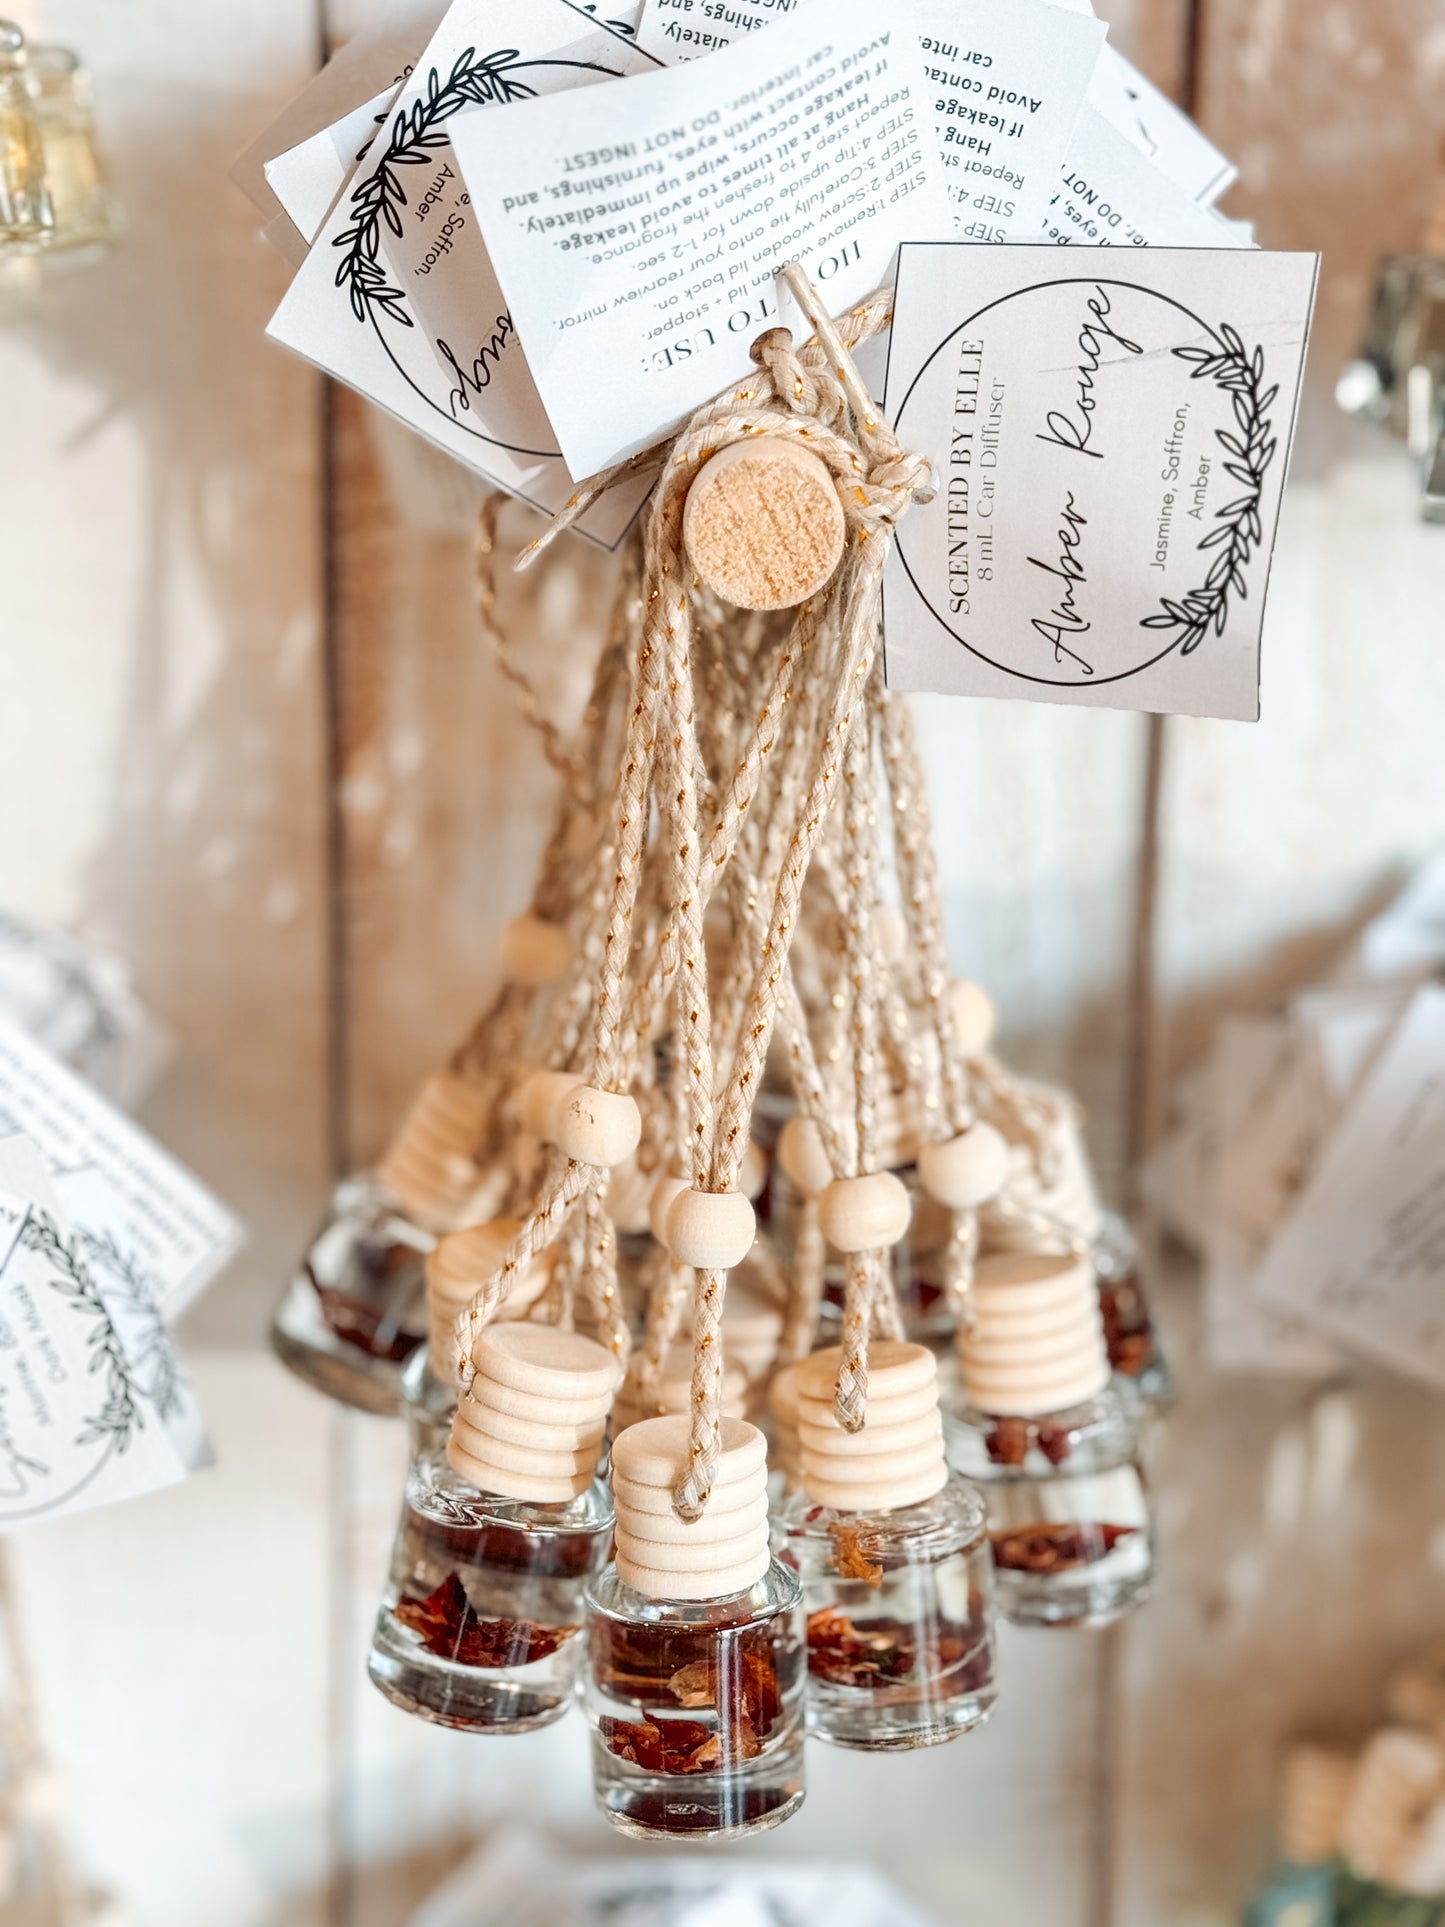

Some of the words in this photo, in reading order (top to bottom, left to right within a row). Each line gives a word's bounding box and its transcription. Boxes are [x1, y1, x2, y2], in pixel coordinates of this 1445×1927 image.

[806, 45, 834, 69] car
[840, 34, 890, 73] Avoid
[918, 35, 959, 62] inte
[962, 50, 993, 68] car
[874, 58, 888, 77] If
[723, 64, 803, 116] interior.
[767, 66, 837, 115] contact
[804, 69, 871, 117] leakage
[986, 85, 1043, 114] Avoid
[690, 109, 722, 133] DO
[823, 92, 870, 128] Hang
[855, 85, 911, 129] Repeat
[934, 98, 1006, 134] leakage
[644, 126, 687, 153] NOT
[722, 110, 764, 139] with
[732, 113, 800, 155] occurs,
[802, 123, 821, 141] at
[816, 124, 850, 151] step
[876, 107, 914, 141] STEP
[1007, 121, 1024, 139] If
[552, 141, 639, 174] INGEST.
[667, 134, 719, 163] eyes,
[775, 136, 799, 159] all
[800, 150, 812, 164] 4
[834, 136, 872, 164] 4:Tip
[881, 128, 918, 162] STEP
[943, 126, 992, 157] Hang
[543, 160, 665, 200] furnishings,
[685, 153, 730, 182] wipe
[721, 153, 773, 187] times
[778, 158, 797, 173] to
[778, 162, 831, 199] upside
[885, 149, 923, 183] STEP
[963, 159, 1025, 191] Repeat
[414, 162, 456, 223] Amber
[655, 177, 681, 195] up
[697, 183, 719, 199] to
[714, 171, 776, 210] freshen
[794, 156, 877, 215] 3:Carefully
[819, 176, 881, 223] 2:Screw
[889, 170, 927, 203] STEP
[943, 183, 970, 204] 4:
[1062, 172, 1099, 206] NOT
[501, 191, 540, 214] and
[519, 190, 652, 234] immediately.
[639, 194, 693, 230] avoid
[682, 206, 711, 225] the
[729, 196, 775, 226] down
[972, 194, 1016, 218] STEP
[1063, 199, 1099, 238] eyes,
[1096, 203, 1123, 228] DO
[553, 221, 636, 252] leakage.
[701, 223, 726, 242] for
[769, 212, 791, 228] tie
[817, 198, 887, 247] 1:Remove
[962, 218, 1007, 244] STEP
[414, 212, 465, 276] Saffron,
[583, 222, 678, 265] fragrance.
[670, 237, 699, 259] 1-2
[728, 226, 765, 251] onto
[752, 220, 816, 263] wooden
[631, 251, 667, 272] sec.
[689, 244, 725, 273] your
[728, 259, 749, 281] lid
[613, 268, 685, 308] rearview
[652, 295, 679, 311] on.
[683, 272, 725, 301] back
[727, 283, 749, 305] lid
[551, 303, 608, 331] mirror.
[641, 303, 710, 341] stopper.
[727, 298, 777, 333] TO
[435, 308, 514, 418] ouge
[641, 328, 716, 372] USE:
[954, 339, 984, 415] ELLE
[1034, 283, 1144, 458] Rouge
[979, 376, 1006, 468] Diffuser
[950, 425, 974, 466] BY
[1160, 402, 1192, 482] Saffron,
[976, 474, 996, 519] Car
[1186, 455, 1212, 521] Amber
[947, 477, 971, 615] SCENTED
[976, 524, 994, 562] mL
[1148, 487, 1179, 573] Jasmine,
[976, 567, 994, 582] 8
[1024, 490, 1095, 676] Amber
